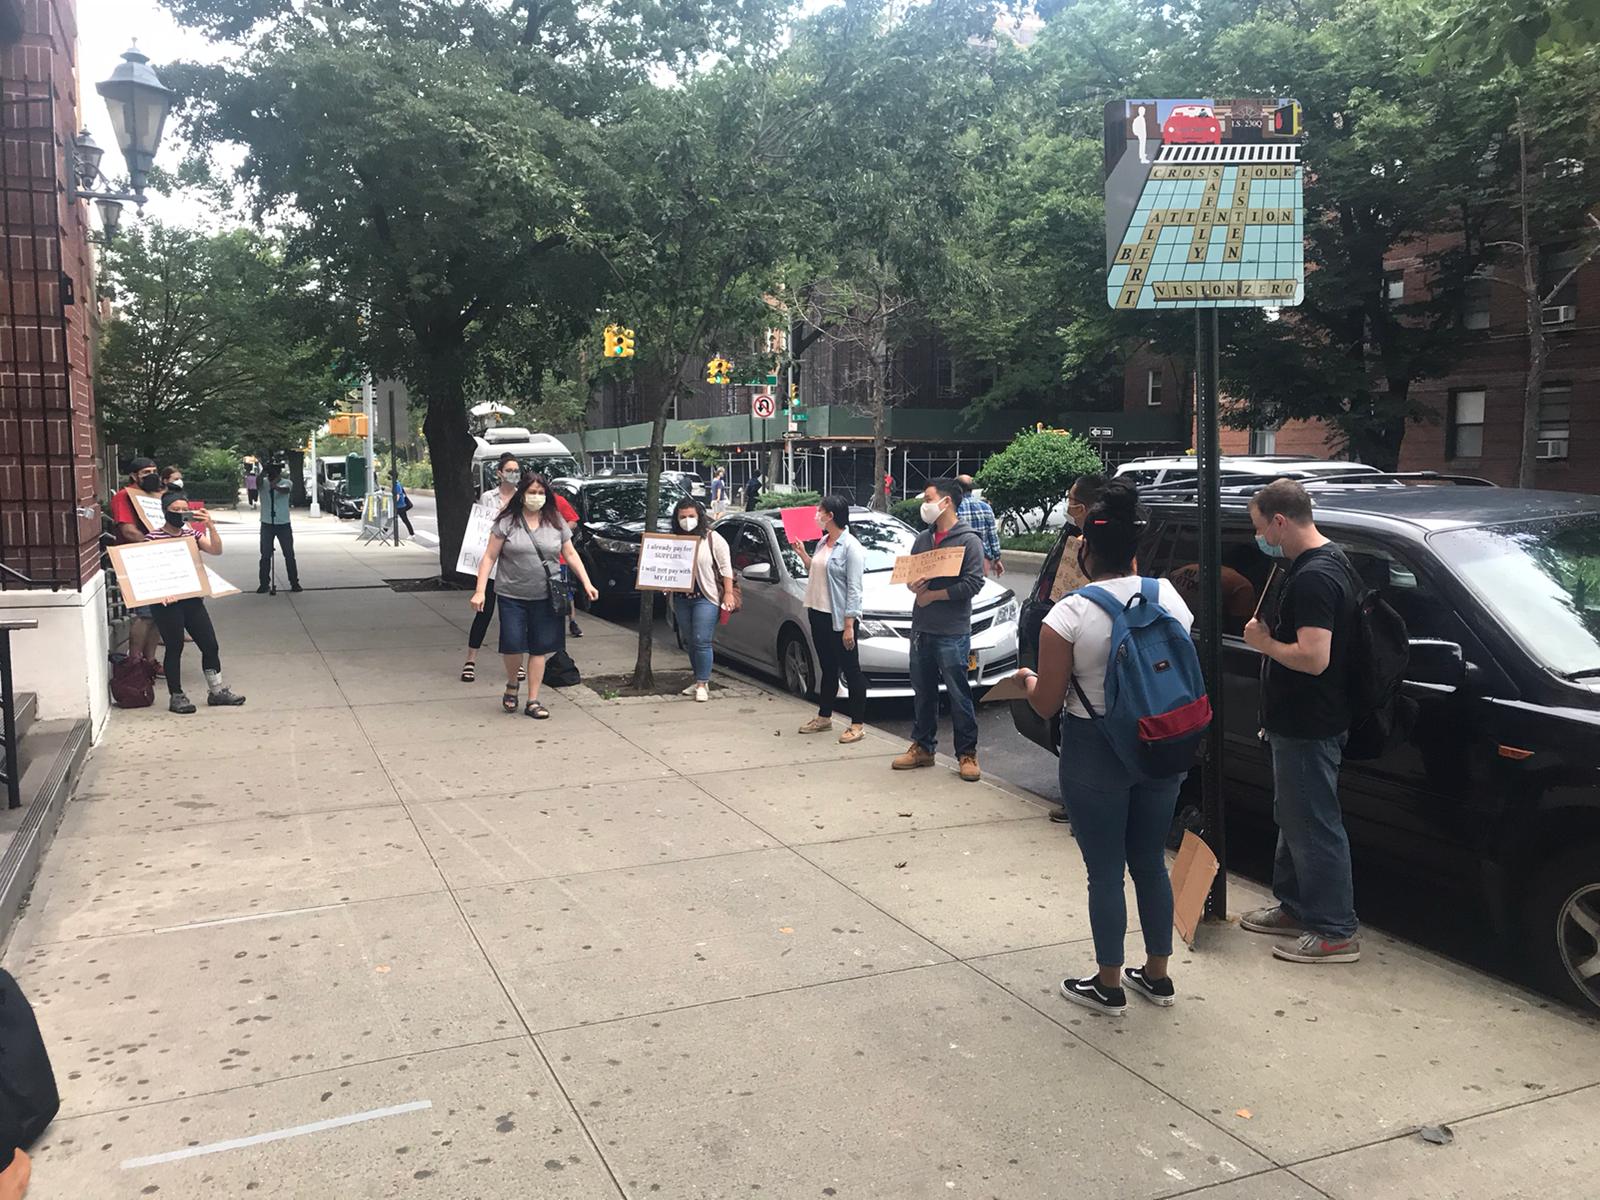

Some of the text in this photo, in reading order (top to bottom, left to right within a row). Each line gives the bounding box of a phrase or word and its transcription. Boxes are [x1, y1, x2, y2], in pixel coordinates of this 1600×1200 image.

[1153, 167, 1220, 178] CROSS
[1241, 167, 1293, 178] LOOK
[1150, 211, 1293, 223] ATTENTION
[1194, 167, 1221, 259] SAFELY
[1228, 167, 1248, 259] LISTEN
[1124, 211, 1161, 305] ALERT
[1156, 282, 1295, 297] VISION ZERO
